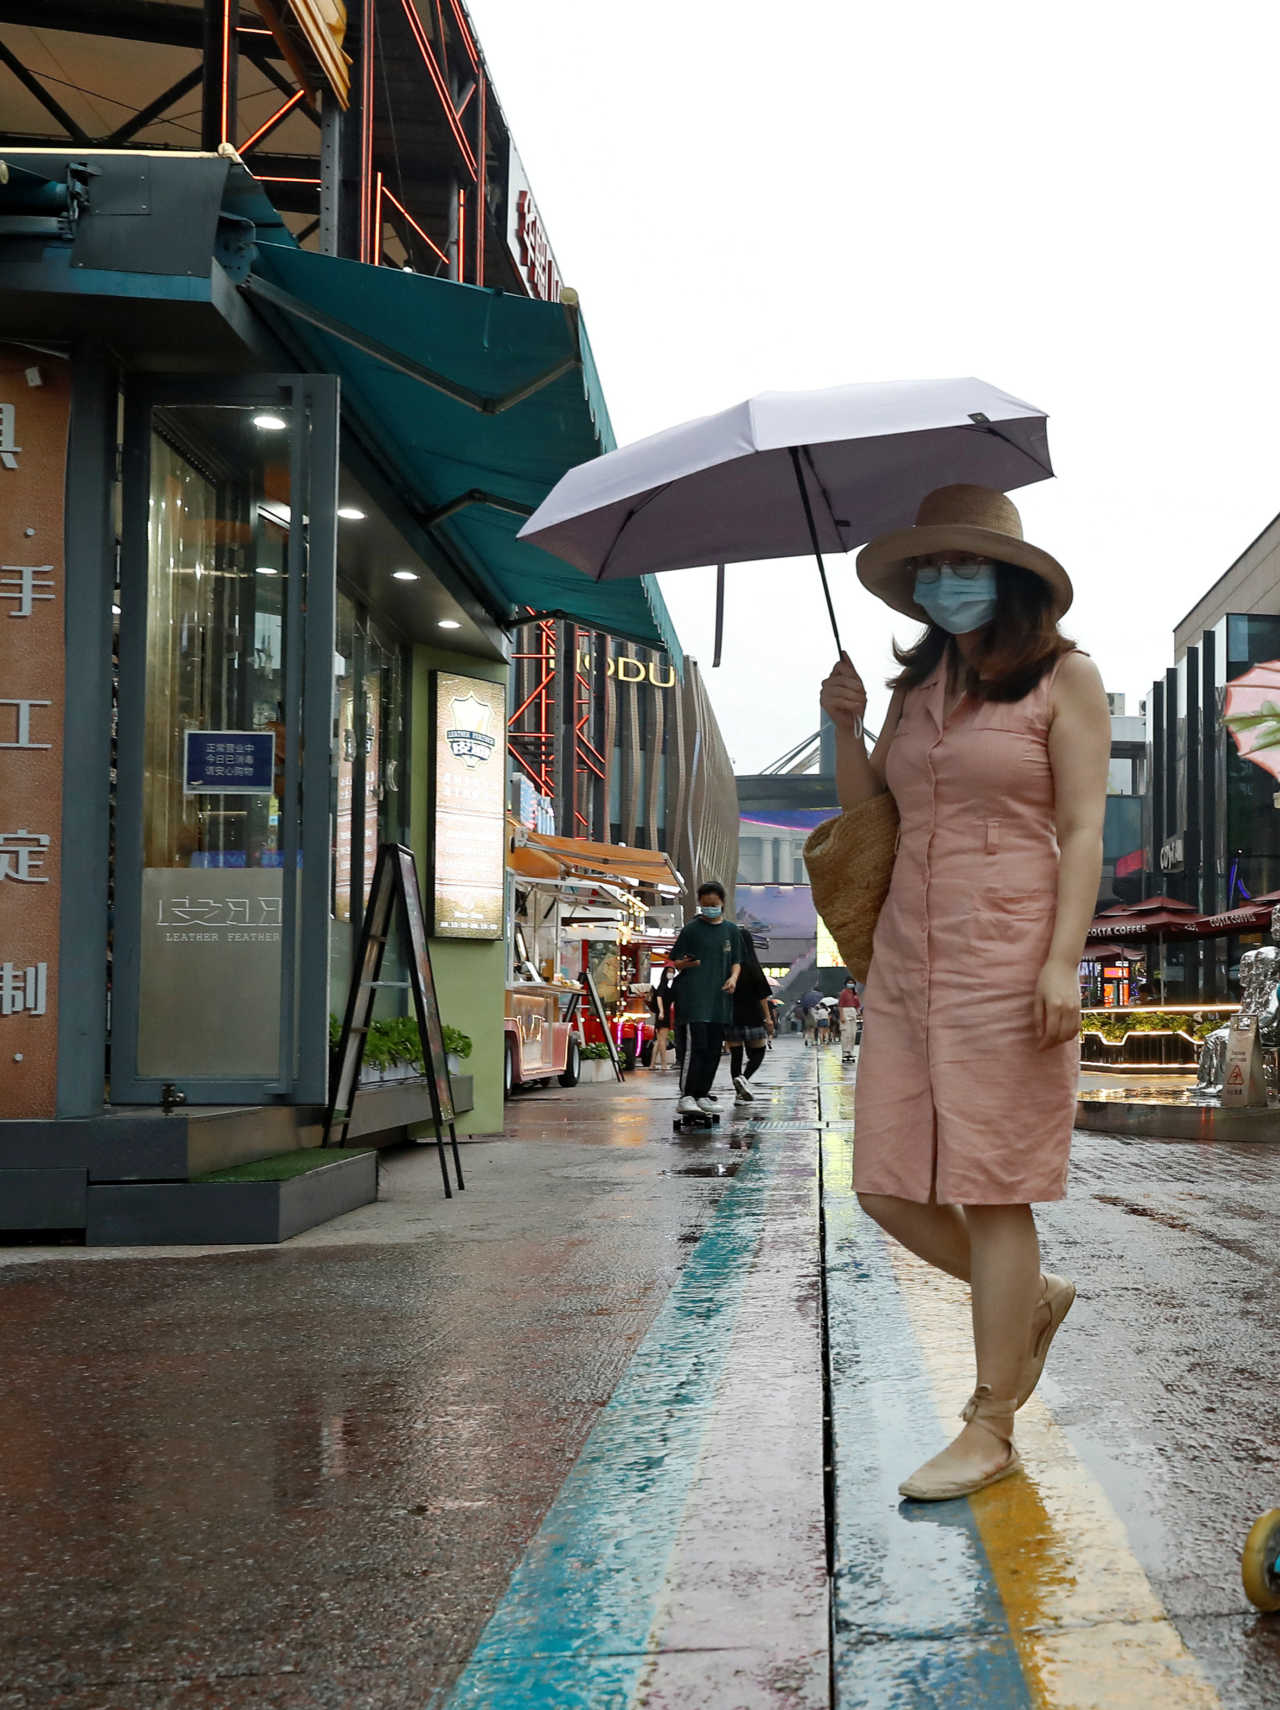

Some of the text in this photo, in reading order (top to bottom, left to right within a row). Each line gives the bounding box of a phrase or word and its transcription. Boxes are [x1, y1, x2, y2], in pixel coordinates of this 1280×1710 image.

[1113, 924, 1147, 936] COFFEE
[165, 933, 280, 942] LEATHER FEATHER
